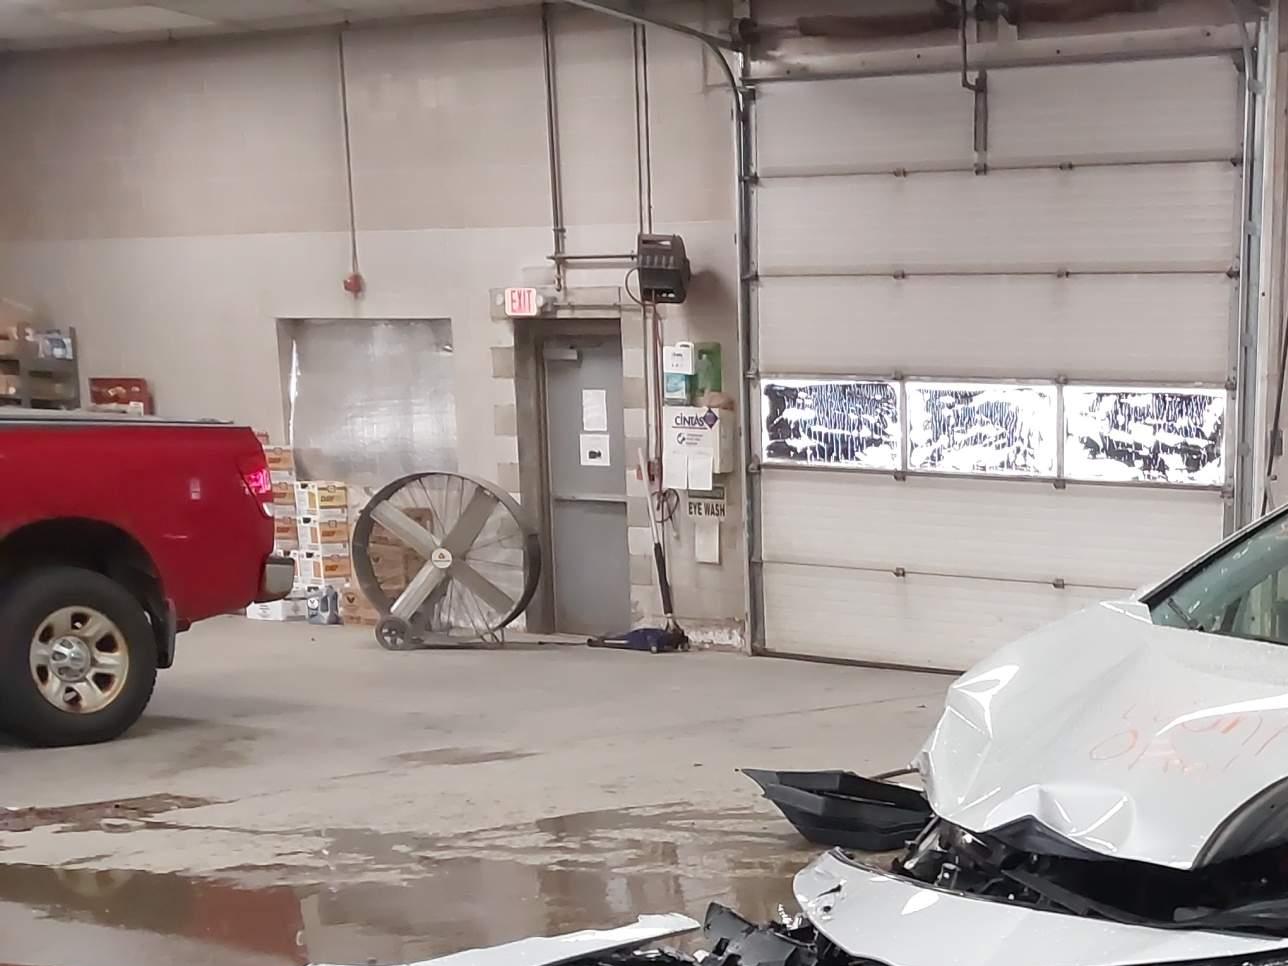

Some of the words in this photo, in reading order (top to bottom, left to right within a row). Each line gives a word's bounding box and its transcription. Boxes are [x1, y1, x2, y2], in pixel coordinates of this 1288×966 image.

[510, 289, 532, 313] EXIT
[674, 412, 705, 426] CINTAS
[688, 502, 703, 516] EYE
[704, 503, 726, 517] WASH
